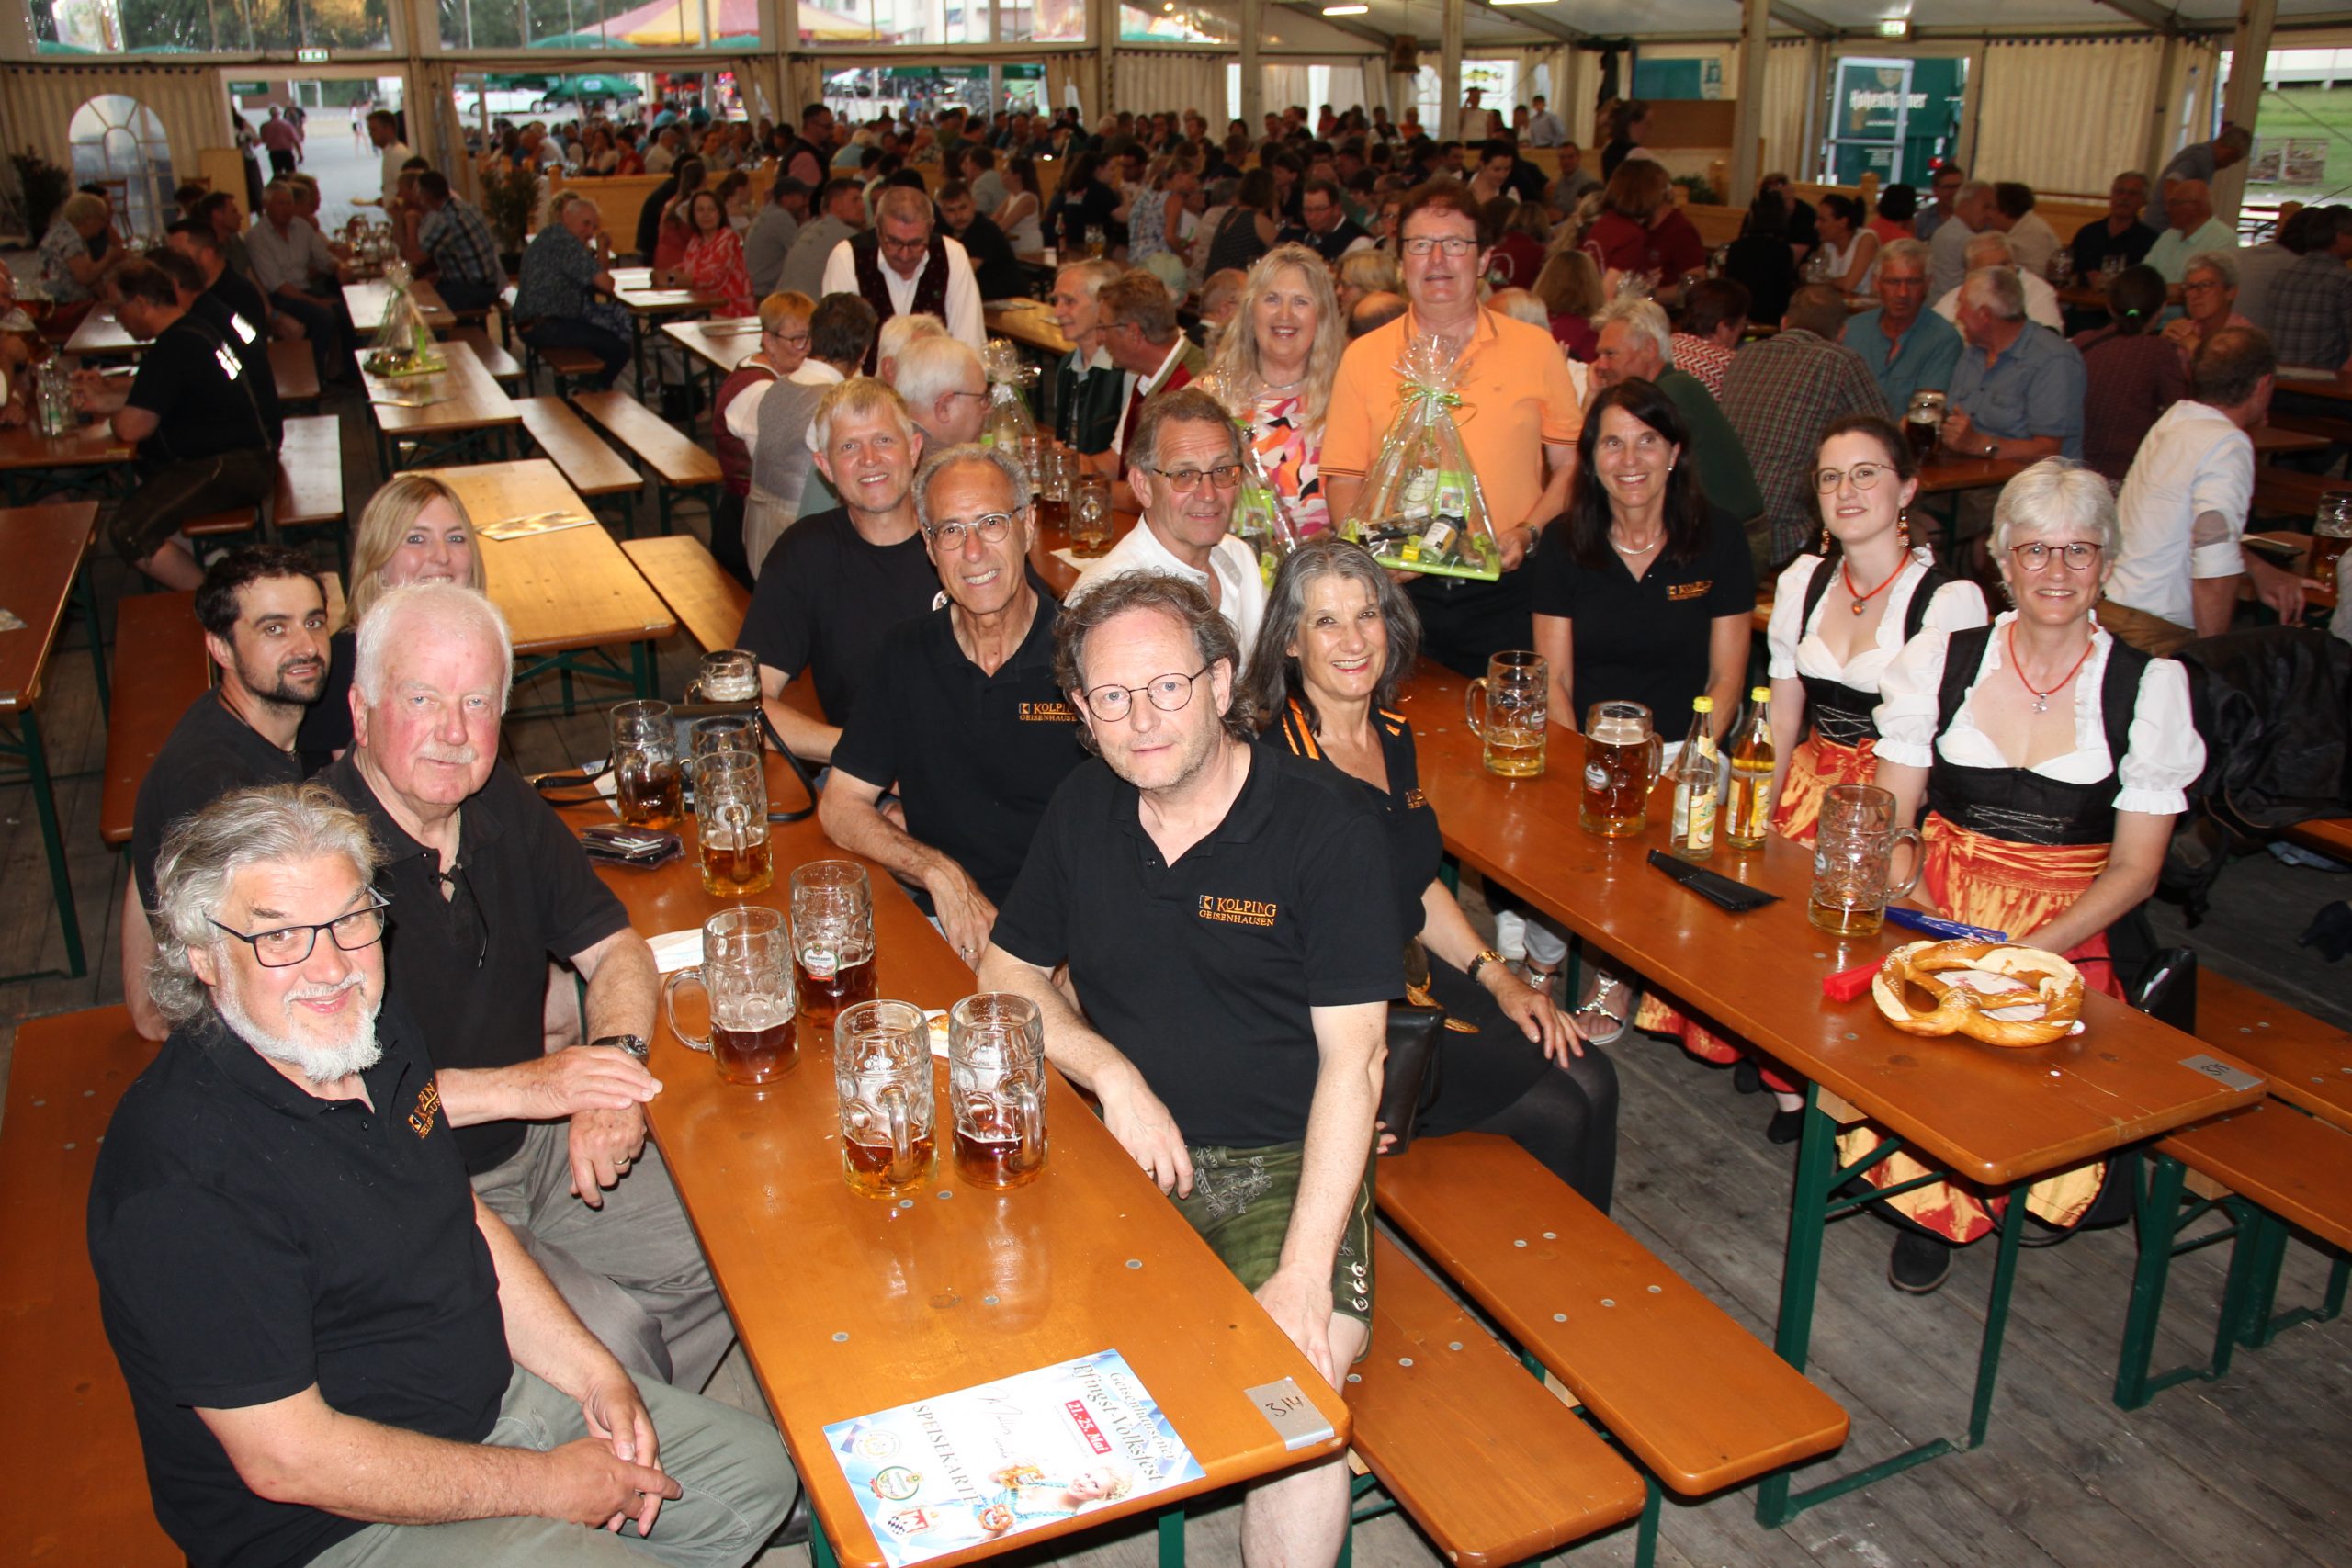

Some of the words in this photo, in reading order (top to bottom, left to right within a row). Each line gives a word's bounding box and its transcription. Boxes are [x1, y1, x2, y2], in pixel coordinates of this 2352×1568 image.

[1199, 909, 1274, 926] GEISENHAUSEN
[1217, 897, 1277, 918] KOLPING
[1067, 1402, 1095, 1432] 21.-25.
[1087, 1431, 1110, 1451] Mai
[1072, 1363, 1166, 1481] Pfingst-Volksfest
[1110, 1371, 1177, 1460] Geisenhausener
[1265, 1395, 1304, 1417] 314
[912, 1404, 982, 1506] SPEISEKARTE
